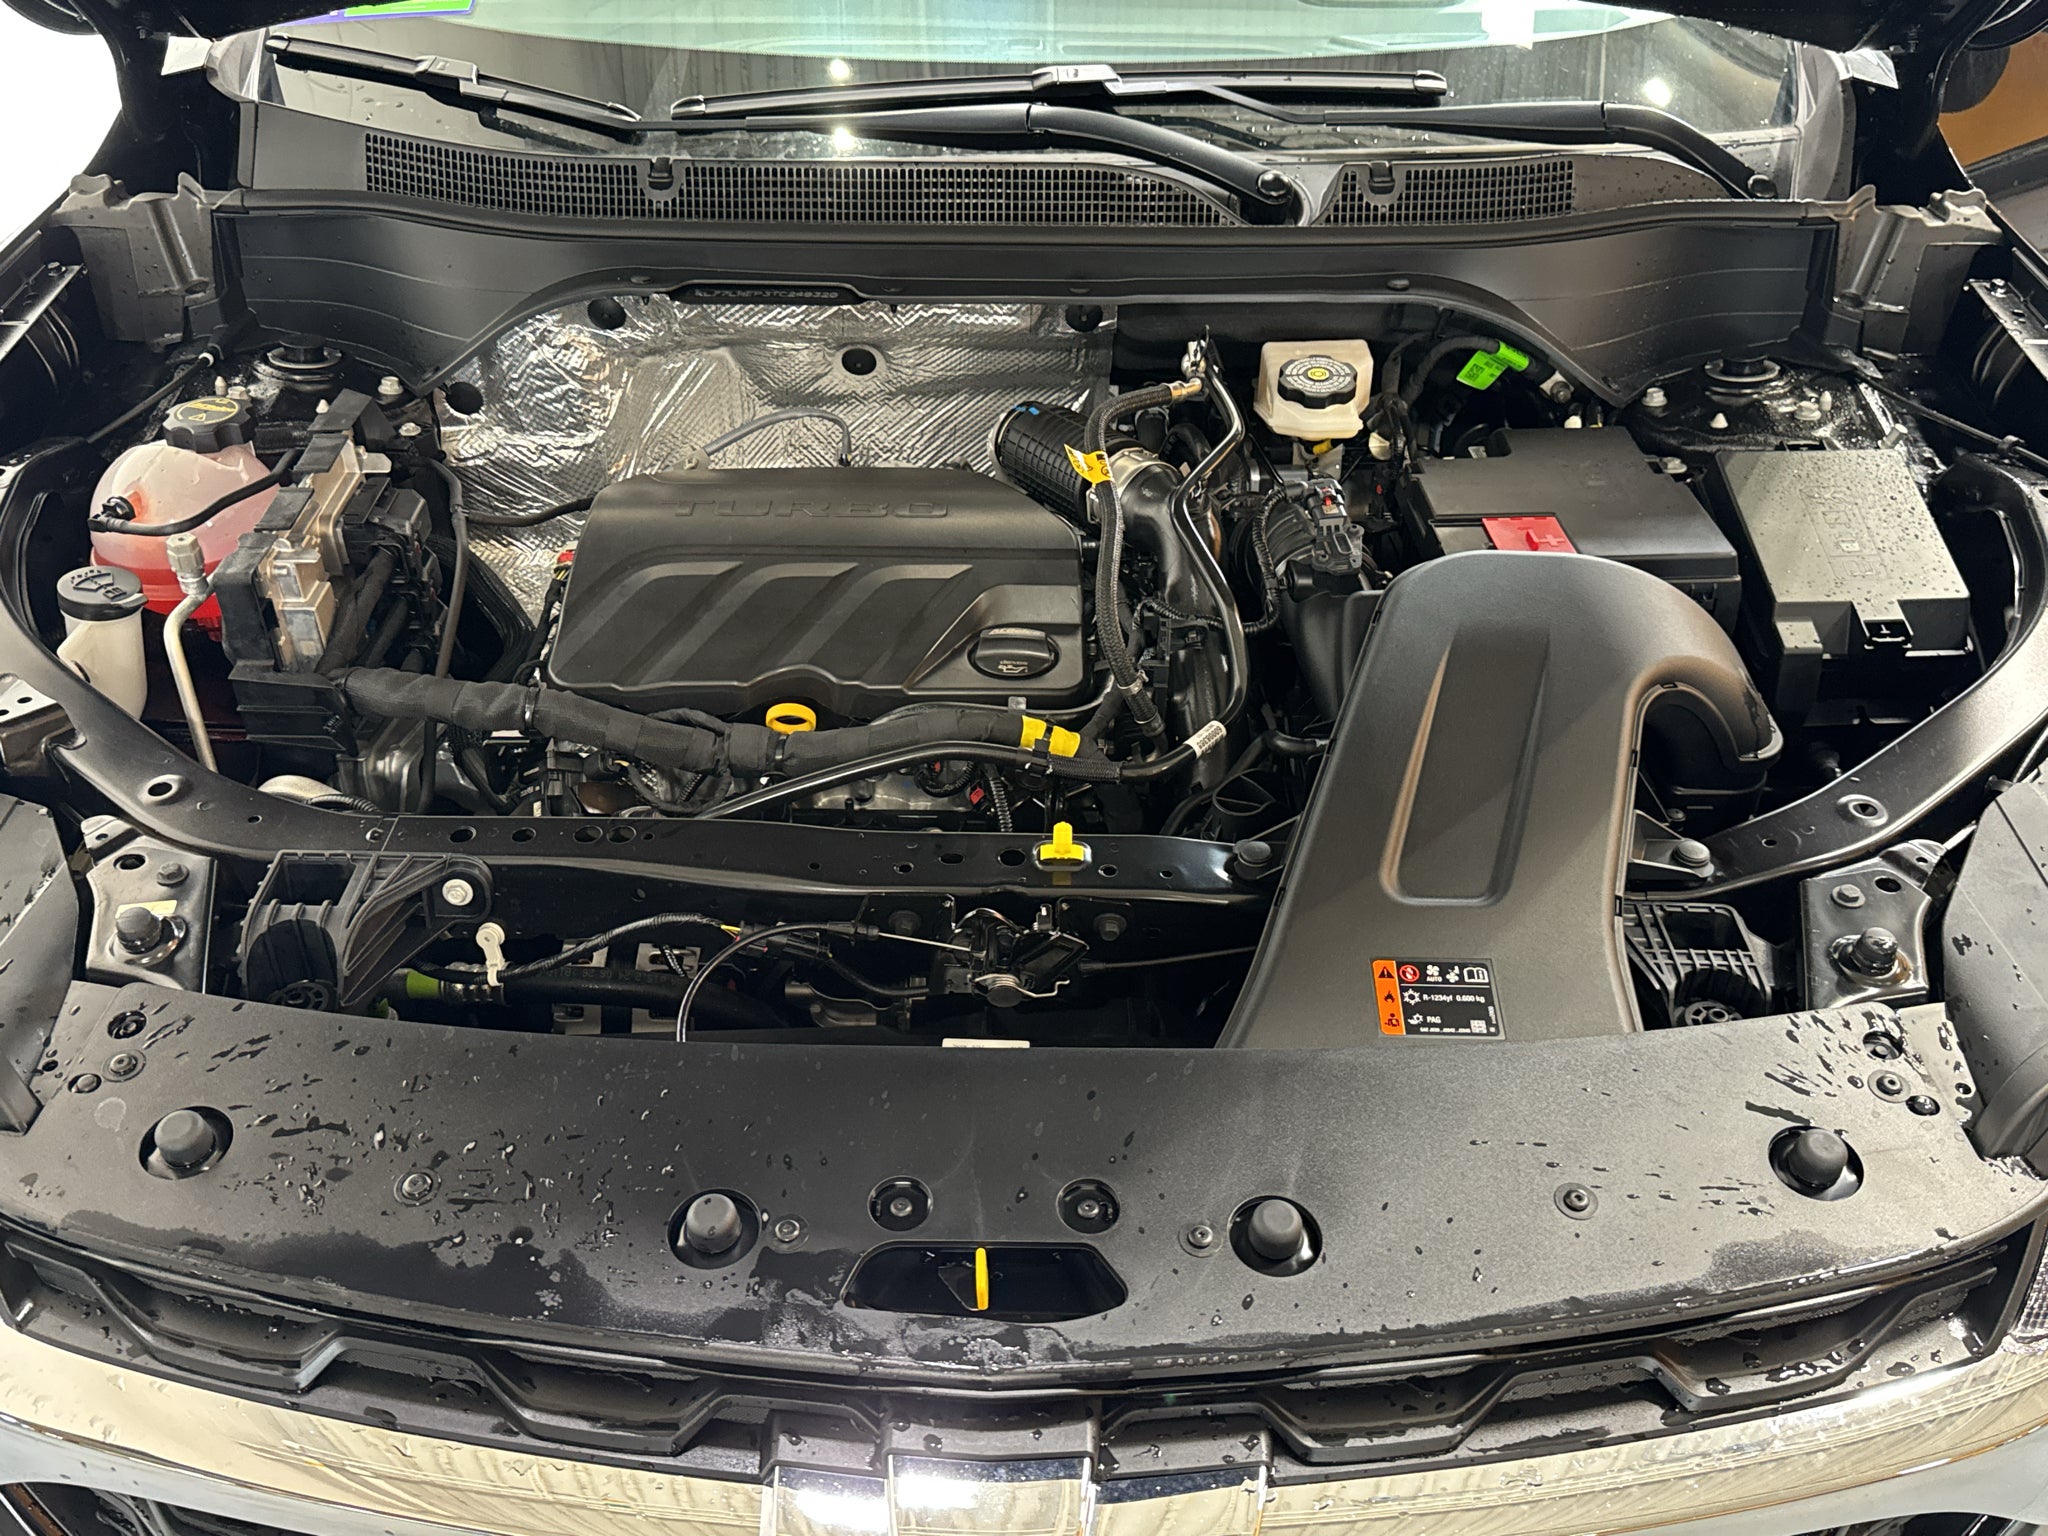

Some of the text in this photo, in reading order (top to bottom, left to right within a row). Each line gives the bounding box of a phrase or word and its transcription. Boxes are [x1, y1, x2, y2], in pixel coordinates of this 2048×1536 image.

[660, 499, 949, 519] TURBO
[1423, 994, 1453, 1003] R-1234yf
[1475, 995, 1485, 1004] kg
[1426, 1016, 1441, 1024] PAG
